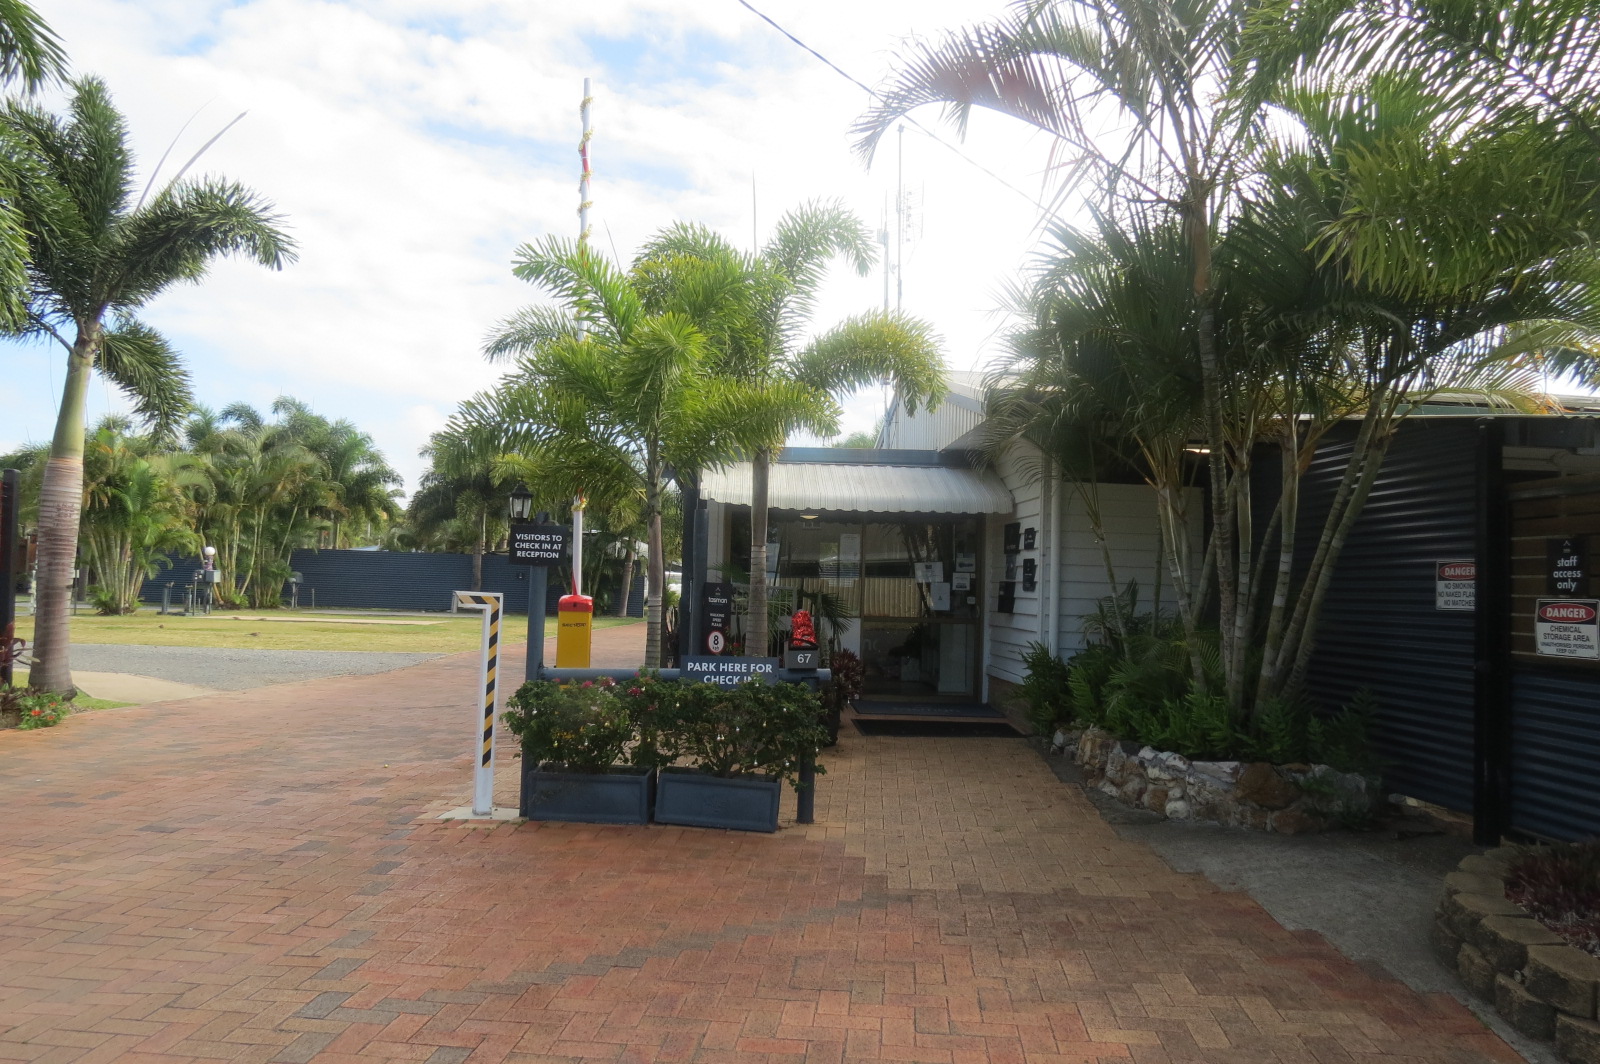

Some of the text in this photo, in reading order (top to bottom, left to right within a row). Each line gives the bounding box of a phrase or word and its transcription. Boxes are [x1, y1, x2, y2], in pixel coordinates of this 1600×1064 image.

[1557, 556, 1577, 567] staff
[1444, 567, 1476, 576] DANGER
[1553, 570, 1581, 578] access
[1556, 578, 1576, 592] only
[1546, 608, 1586, 618] DANGER
[1550, 626, 1582, 634] CHEMICAL
[714, 634, 719, 646] 8
[1543, 633, 1572, 641] STORAGE
[797, 654, 812, 664] 67
[687, 662, 772, 673] PARK HERE FOR
[704, 675, 740, 684] CHECK
